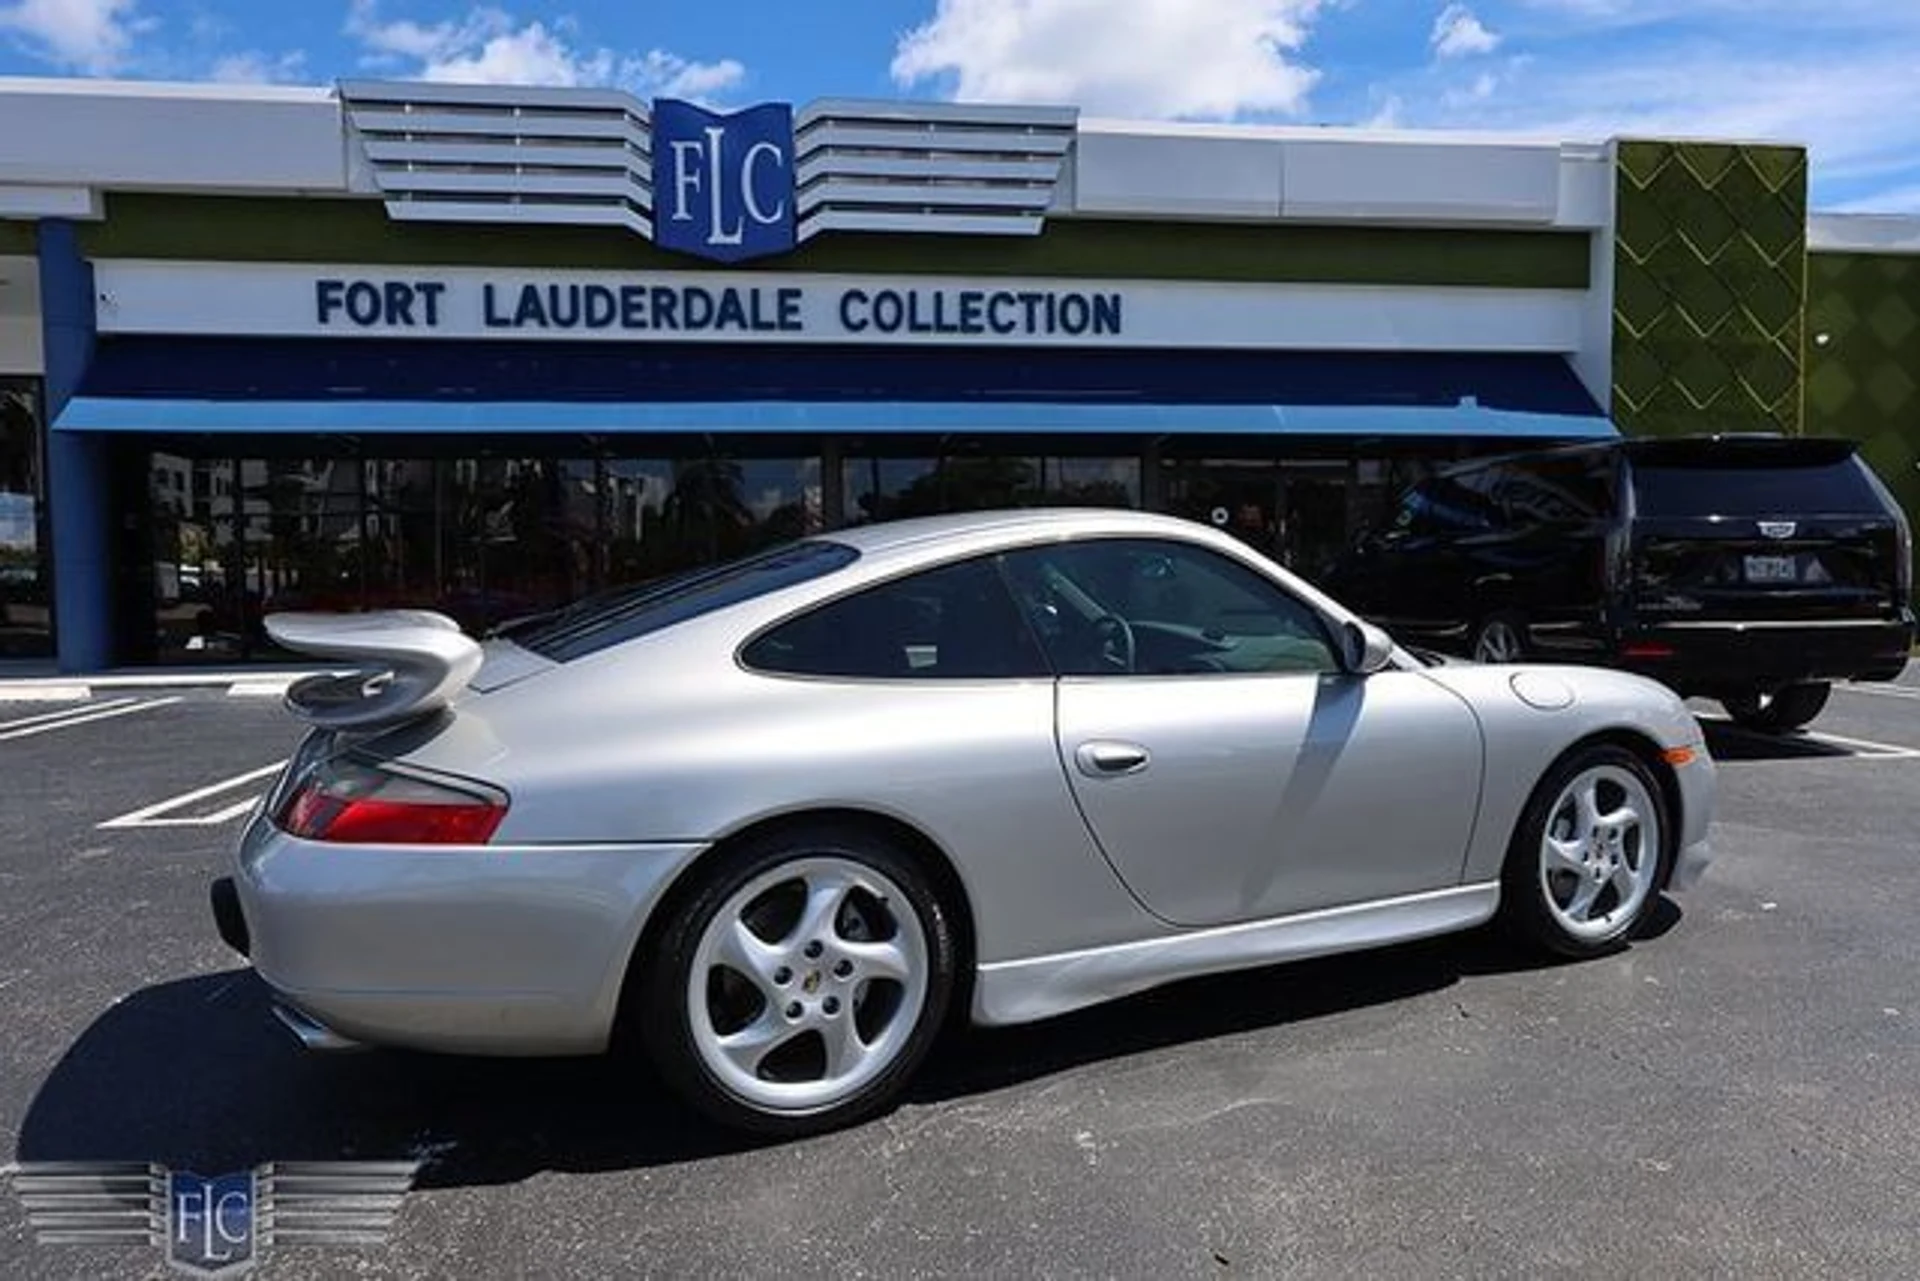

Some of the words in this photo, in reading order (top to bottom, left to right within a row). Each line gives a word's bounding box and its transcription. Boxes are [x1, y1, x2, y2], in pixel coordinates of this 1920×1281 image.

[670, 126, 785, 246] FLC
[316, 279, 445, 327] FORT
[483, 282, 803, 332] LAUDERDALE
[839, 289, 1122, 336] COLLECTION
